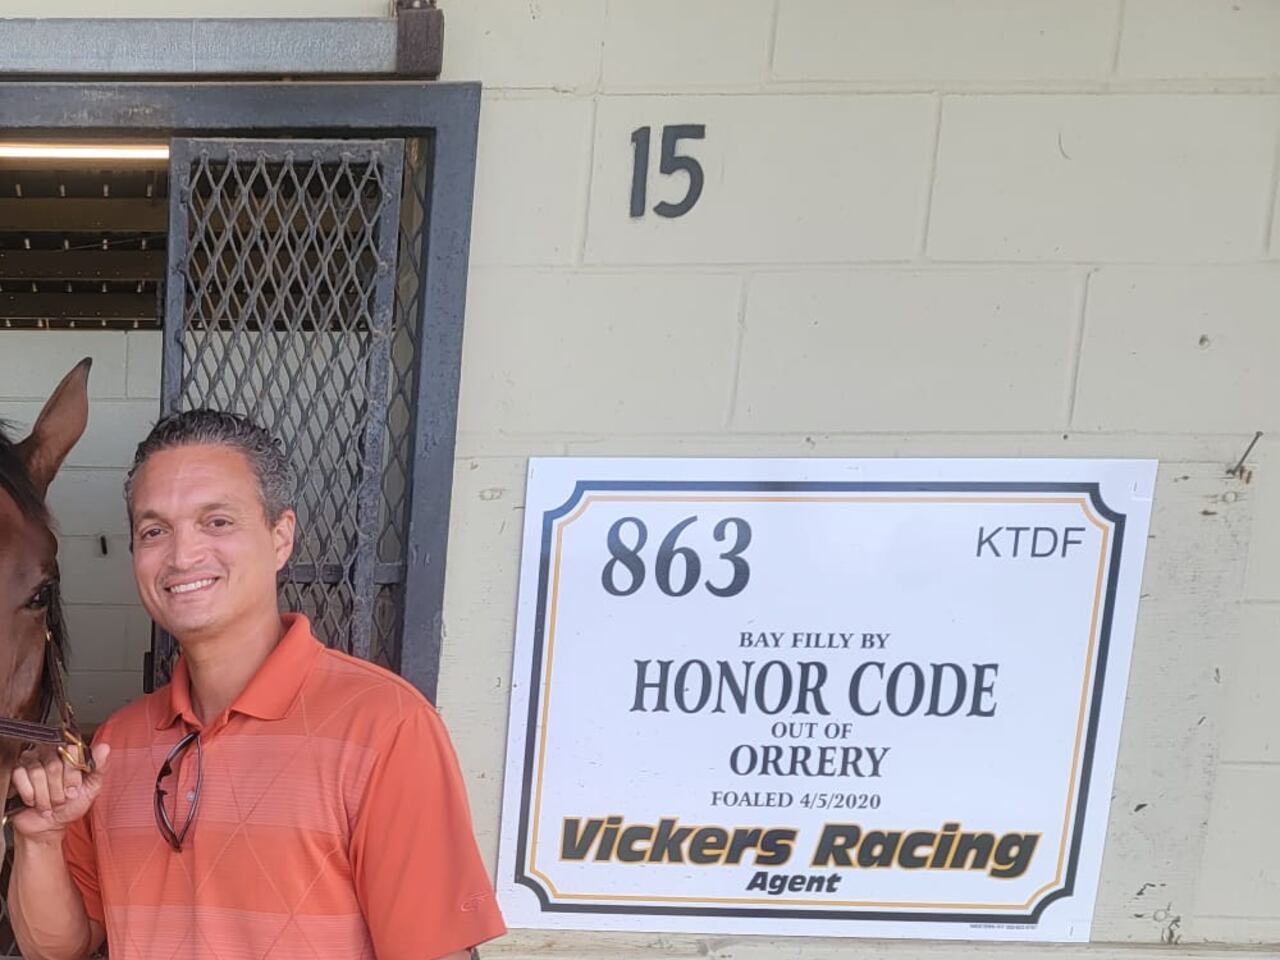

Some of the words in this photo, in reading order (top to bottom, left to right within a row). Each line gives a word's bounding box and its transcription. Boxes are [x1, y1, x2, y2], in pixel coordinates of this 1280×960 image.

[629, 123, 706, 219] 15
[601, 515, 752, 598] 863
[976, 526, 1086, 558] KTDF
[739, 631, 785, 648] BAY
[791, 632, 854, 649] FILLY
[860, 633, 890, 649] BY
[629, 658, 831, 716] HONOR
[848, 661, 999, 718] CODE
[771, 722, 819, 739] OUT
[824, 722, 853, 739] OF
[729, 744, 891, 778] ORRERY
[711, 791, 794, 808] FOALED
[799, 793, 881, 809] 4/5/2020
[560, 816, 798, 866] Vickers
[808, 823, 1040, 880] Racing
[746, 872, 841, 895] Agent
